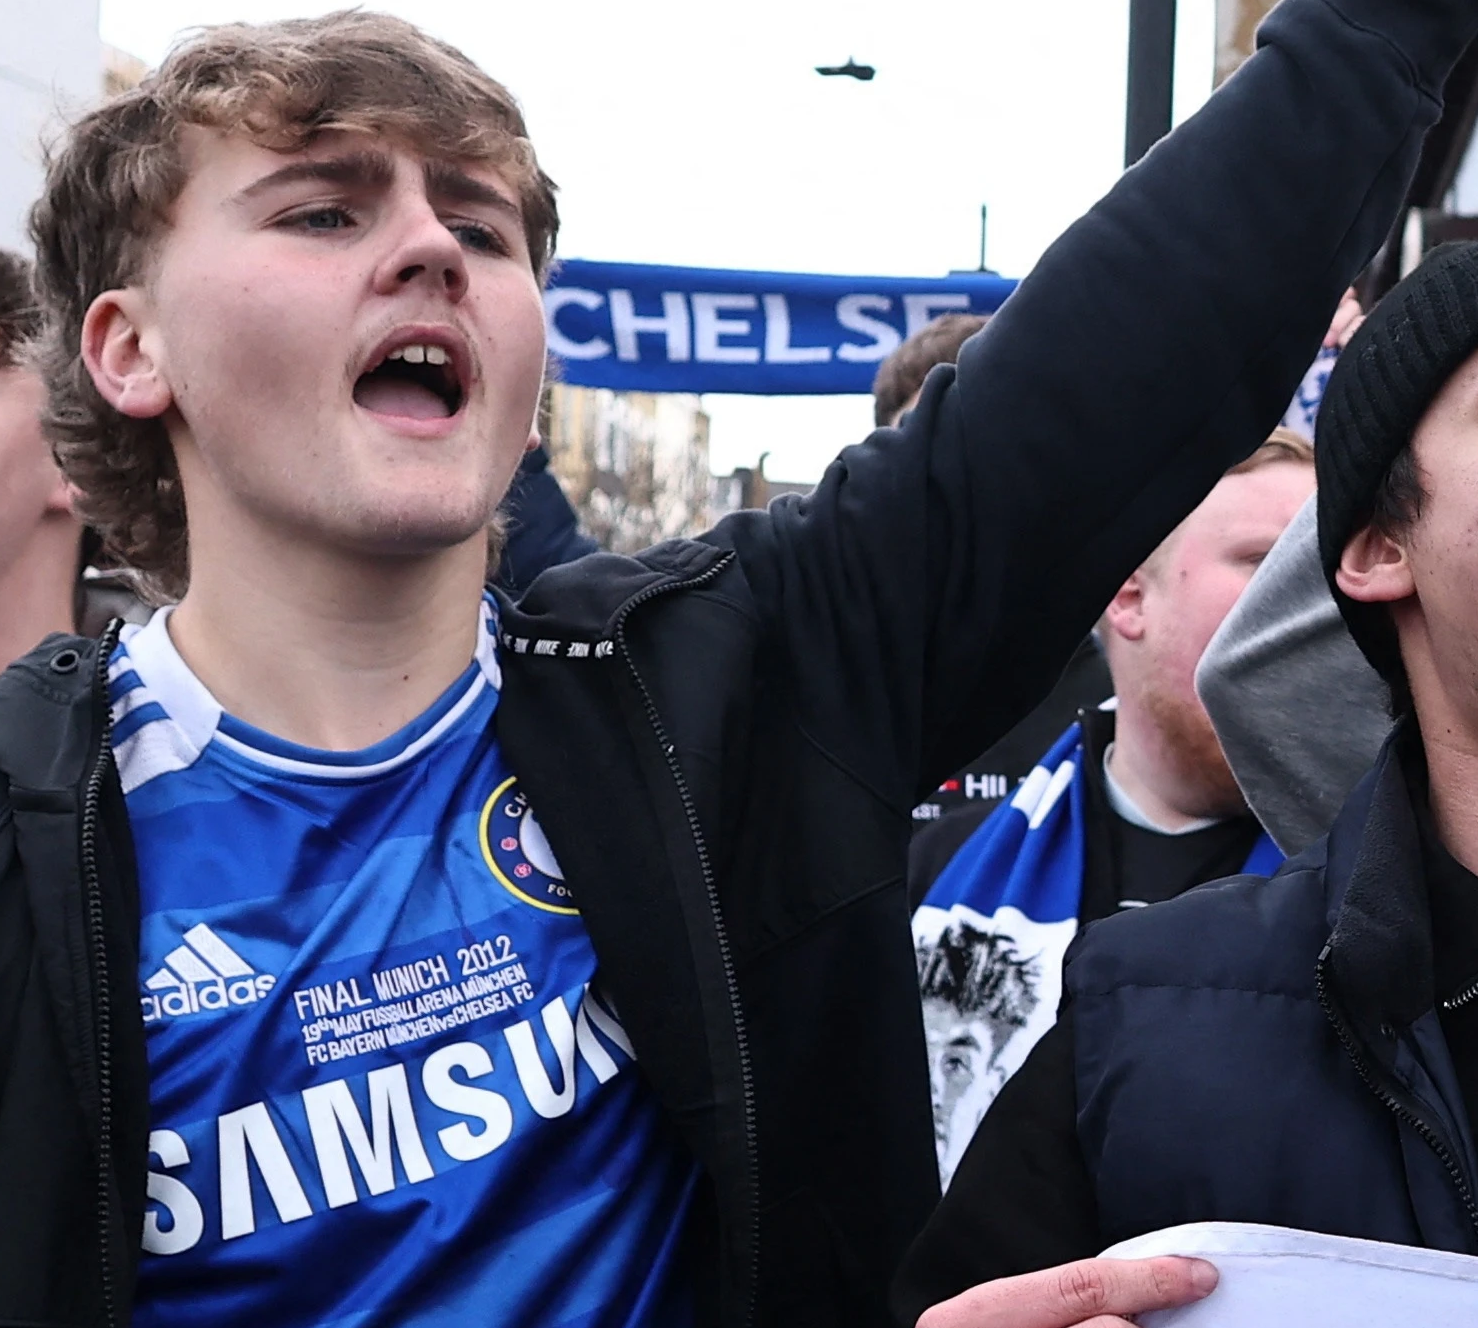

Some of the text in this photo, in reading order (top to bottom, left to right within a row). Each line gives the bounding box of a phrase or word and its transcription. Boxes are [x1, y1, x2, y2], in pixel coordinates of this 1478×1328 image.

[141, 974, 277, 1021] adidas
[293, 935, 518, 1020] FINAL MUNICH 2012
[327, 1029, 387, 1061] BAYERN
